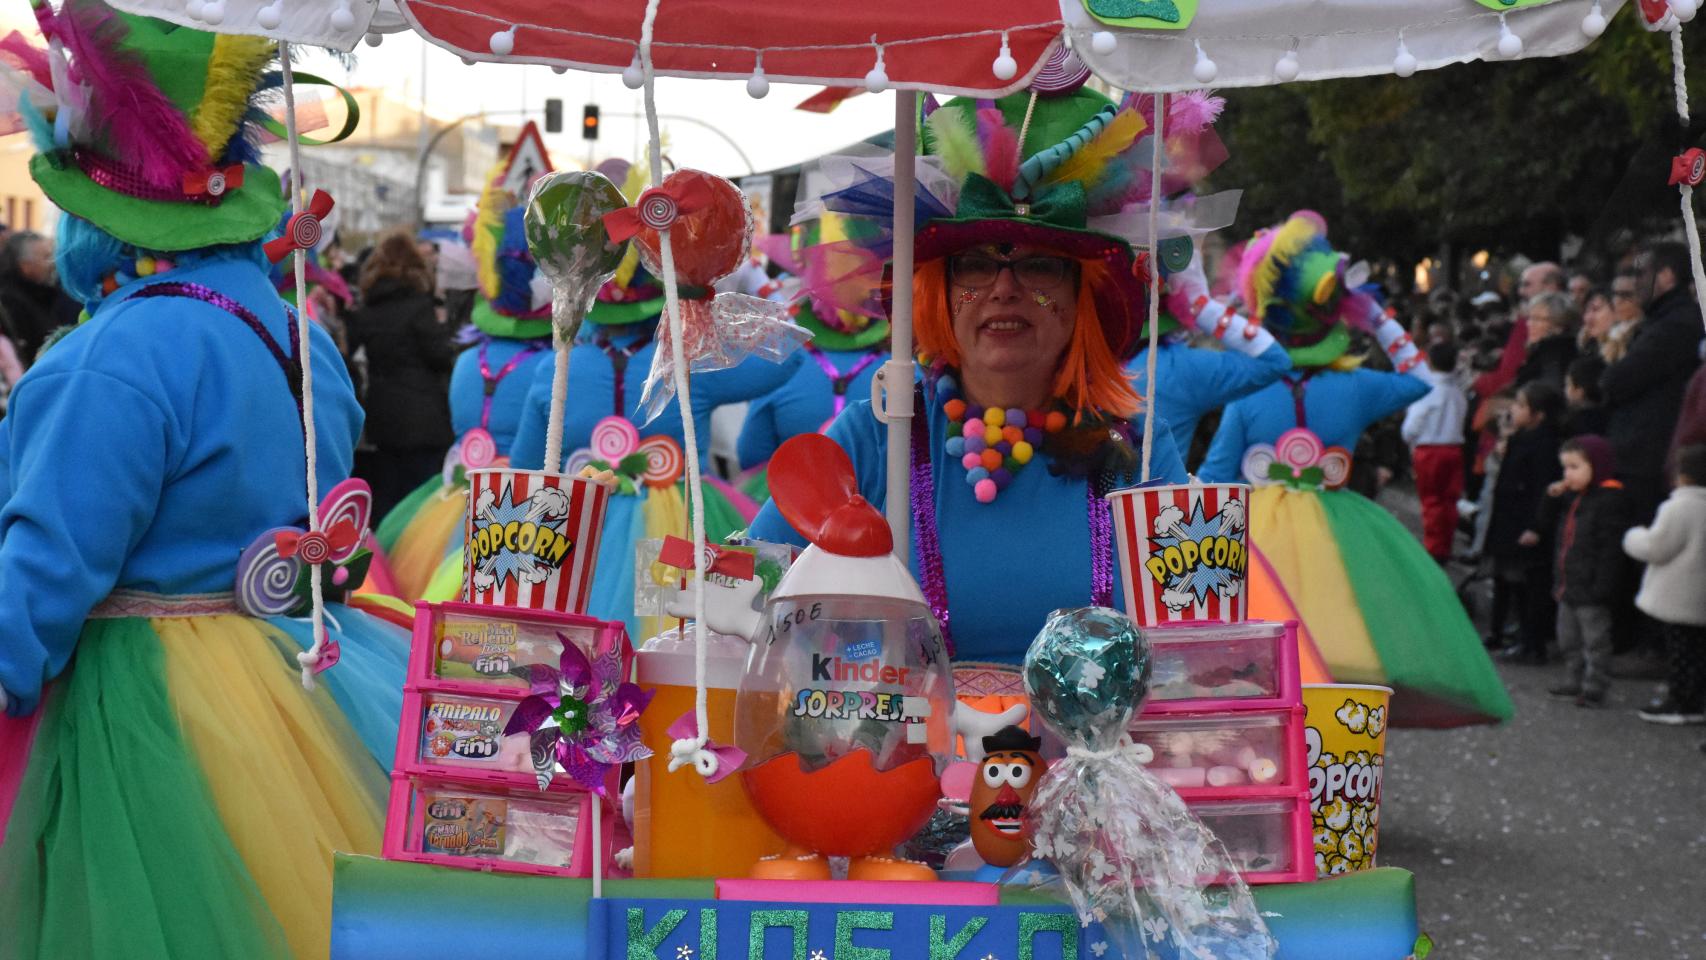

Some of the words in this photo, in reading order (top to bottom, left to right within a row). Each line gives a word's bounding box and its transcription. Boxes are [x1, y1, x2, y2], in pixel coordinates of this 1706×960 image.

[470, 520, 574, 569] POPCORN
[1145, 535, 1248, 587] POPCORN
[852, 641, 875, 651] LECHE
[853, 648, 877, 657] CACAO
[475, 655, 509, 673] Fini
[812, 653, 910, 685] Kinder
[455, 738, 492, 755] Fini
[431, 803, 462, 818] Fini
